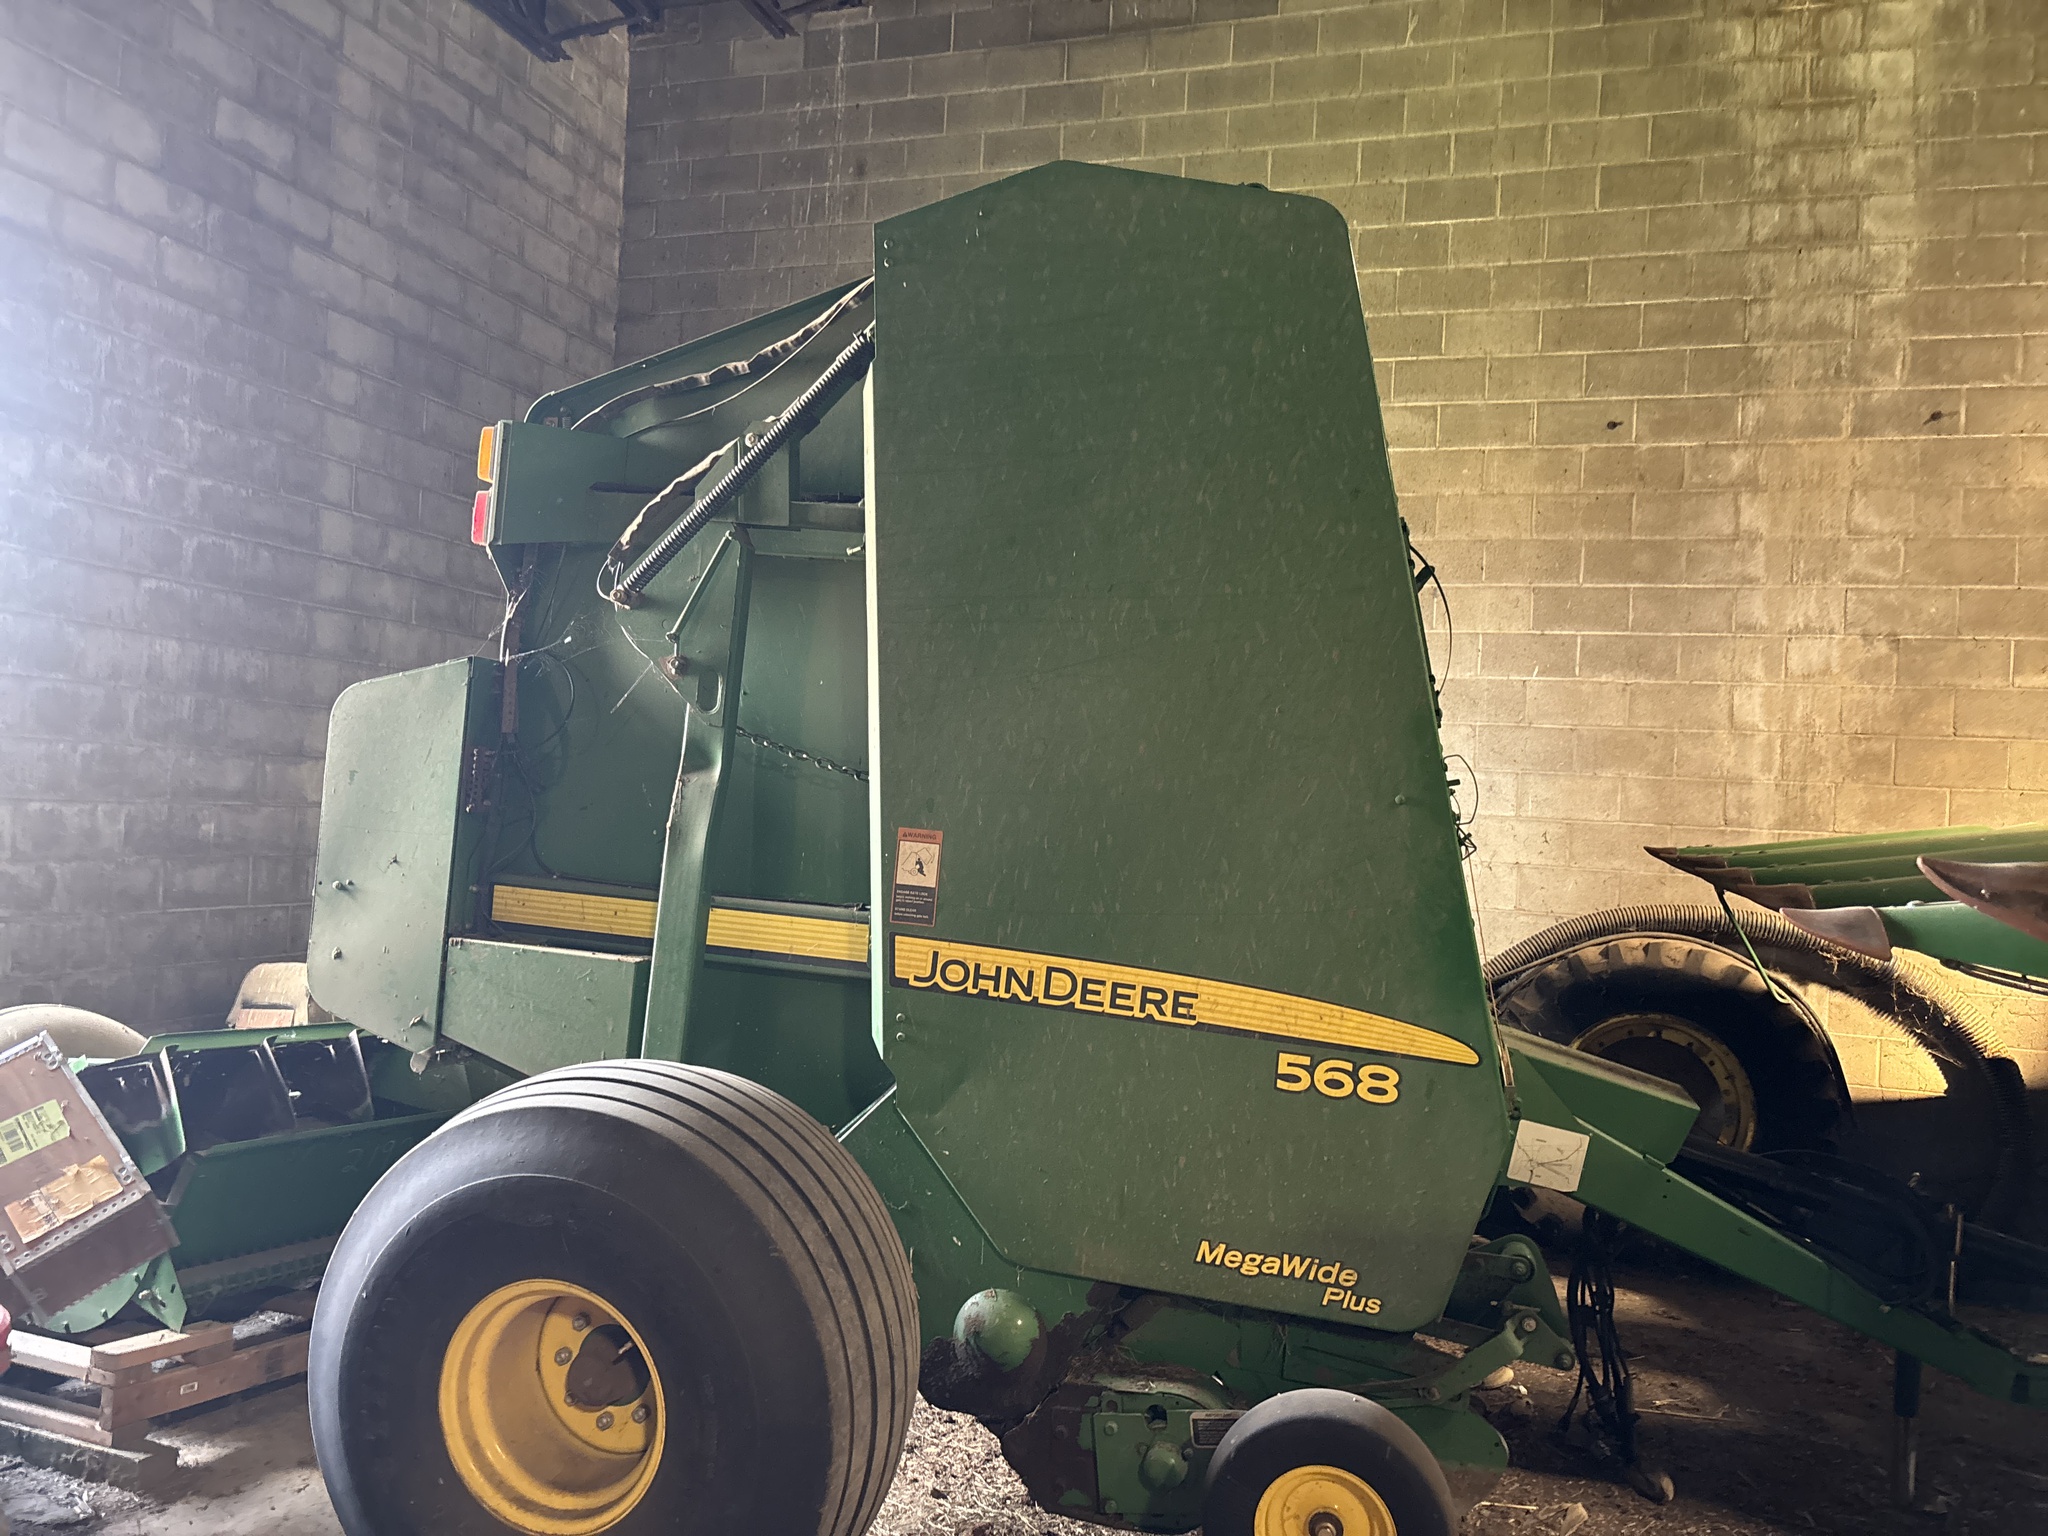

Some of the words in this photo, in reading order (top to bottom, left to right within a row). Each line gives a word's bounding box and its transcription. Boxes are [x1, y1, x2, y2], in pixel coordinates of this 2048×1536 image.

[907, 831, 937, 840] WARNING
[912, 950, 1035, 997] JOHN
[1043, 965, 1200, 1022] DEERE
[1275, 1052, 1400, 1104] 568
[1195, 1240, 1358, 1288] MegaWide
[1321, 1286, 1382, 1315] Plus
